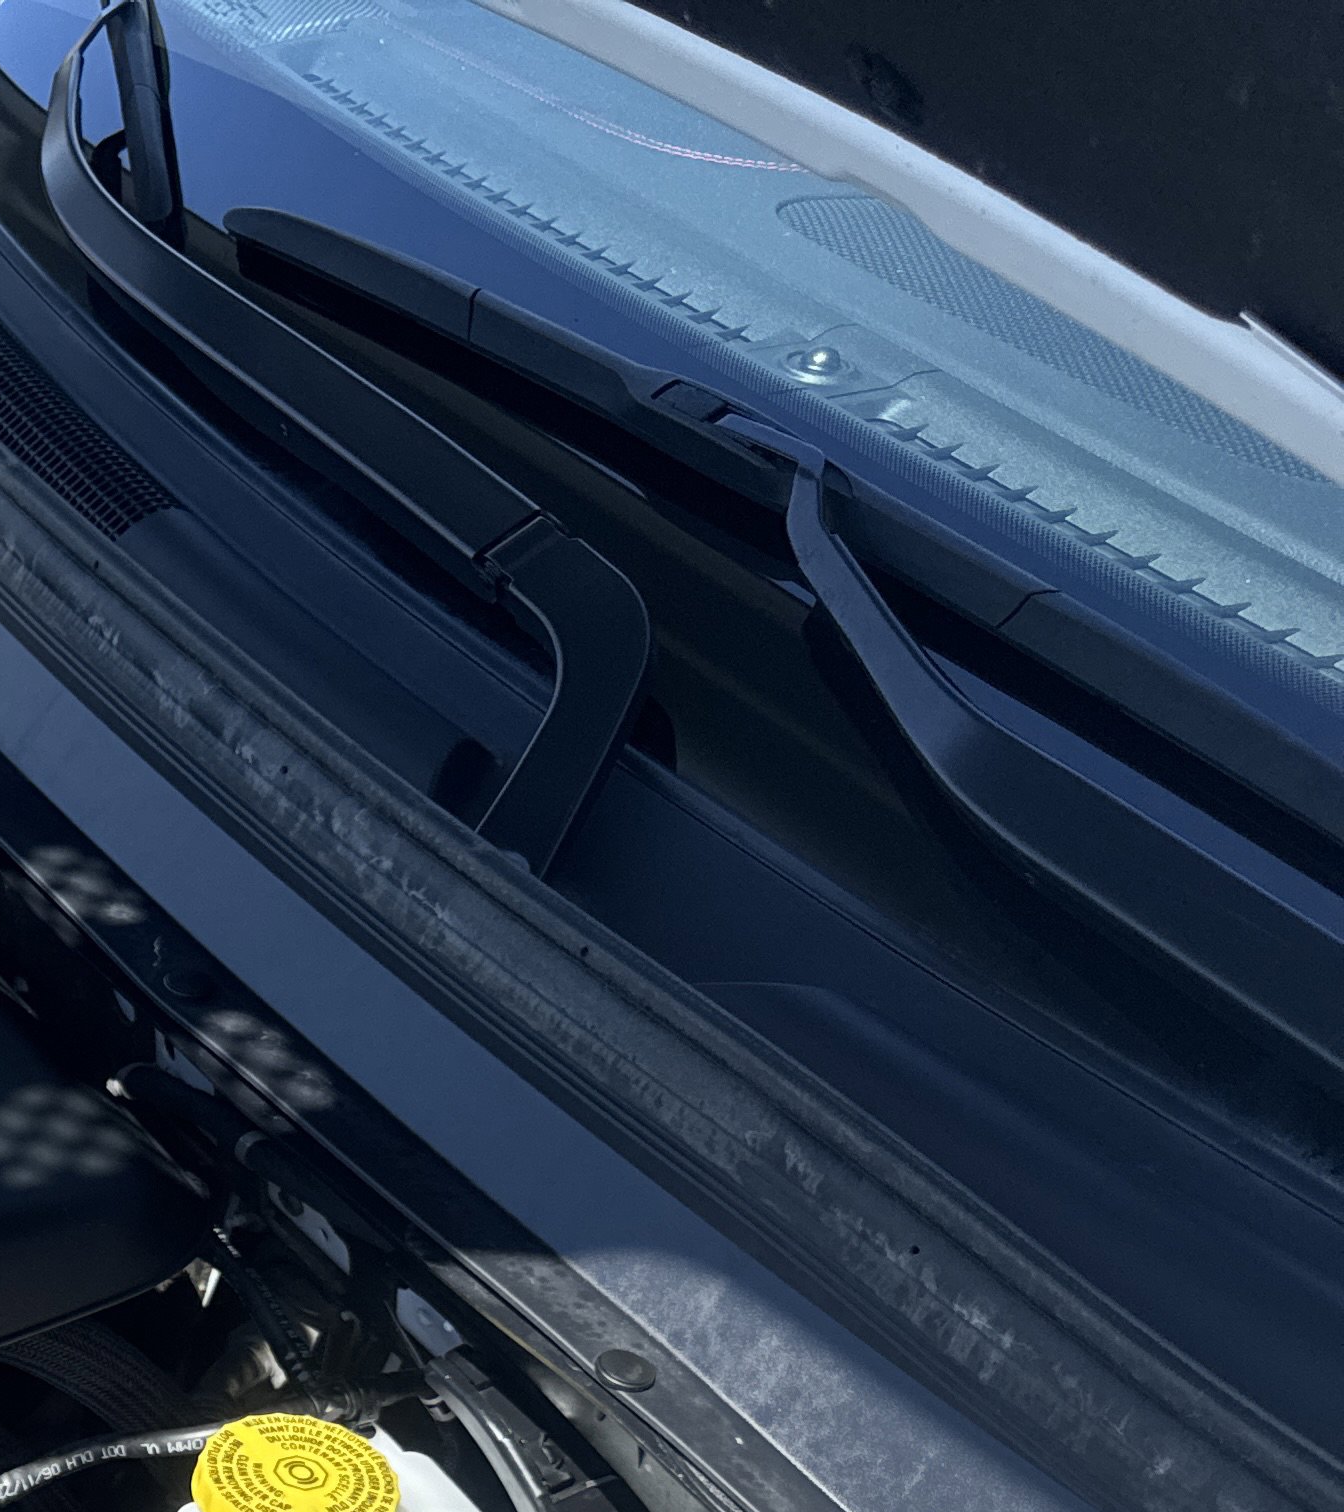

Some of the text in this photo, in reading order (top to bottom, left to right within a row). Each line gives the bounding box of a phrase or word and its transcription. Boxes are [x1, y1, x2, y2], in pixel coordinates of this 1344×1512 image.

[215, 1428, 235, 1443] DOT
[255, 1425, 291, 1435] AVANT
[290, 1425, 305, 1434] DE
[308, 1428, 322, 1437] LE
[322, 1432, 366, 1459] RETIRER
[264, 1434, 282, 1443] DU
[280, 1434, 324, 1447] LIQUIDE
[325, 1444, 348, 1458] DOT
[66, 1450, 93, 1469] DLH
[101, 1444, 125, 1459] DOT
[222, 1437, 244, 1464] BEFORE
[278, 1442, 351, 1471] CONTENANT
[236, 1453, 292, 1512] CLEAN FILLER CAP
